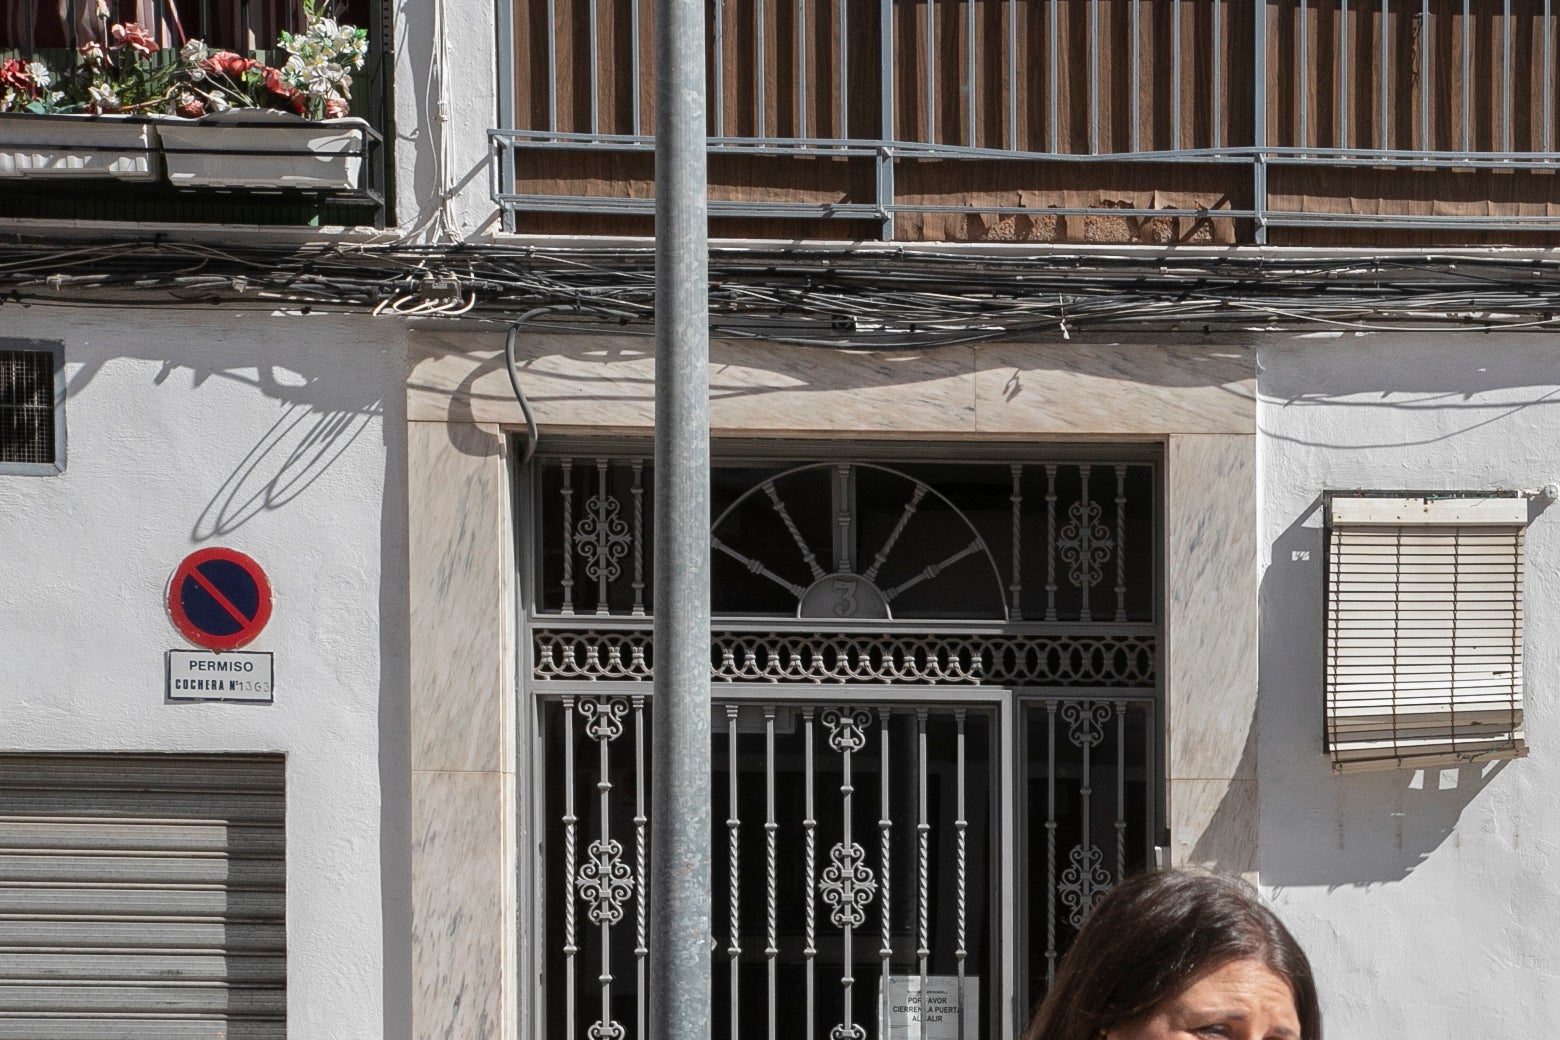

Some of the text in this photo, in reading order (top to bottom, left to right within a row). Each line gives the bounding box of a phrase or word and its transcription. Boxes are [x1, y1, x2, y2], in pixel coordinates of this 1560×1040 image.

[189, 660, 254, 672] PERMISO
[175, 678, 225, 691] COCHERA
[934, 1006, 960, 1014] PUERT
